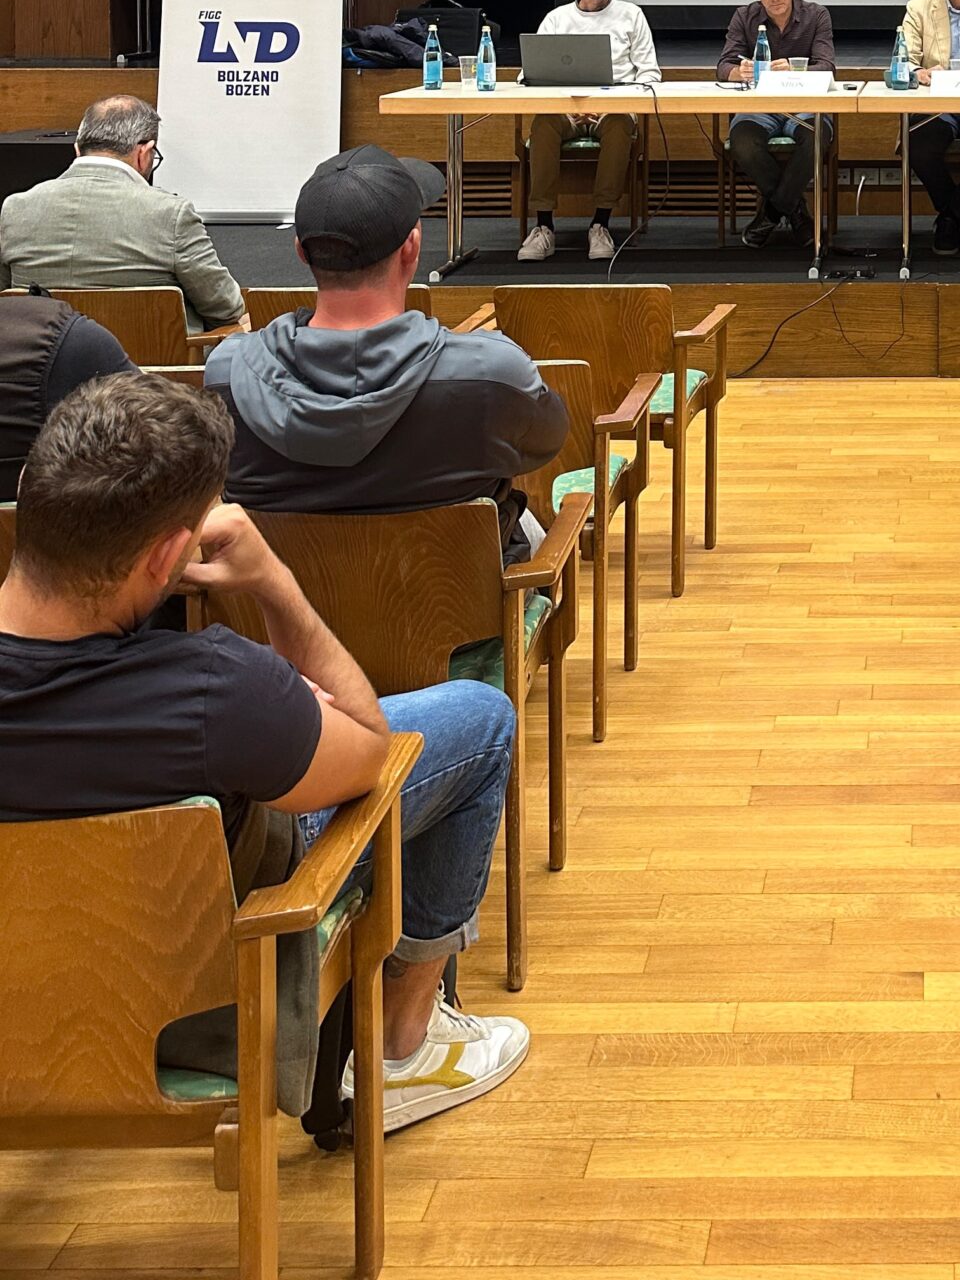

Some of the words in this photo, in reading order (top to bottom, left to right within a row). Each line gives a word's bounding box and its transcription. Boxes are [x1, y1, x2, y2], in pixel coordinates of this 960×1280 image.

[198, 10, 222, 20] FIGC
[197, 21, 301, 63] LND
[217, 70, 279, 83] BOLZANO
[225, 84, 270, 97] BOZEN
